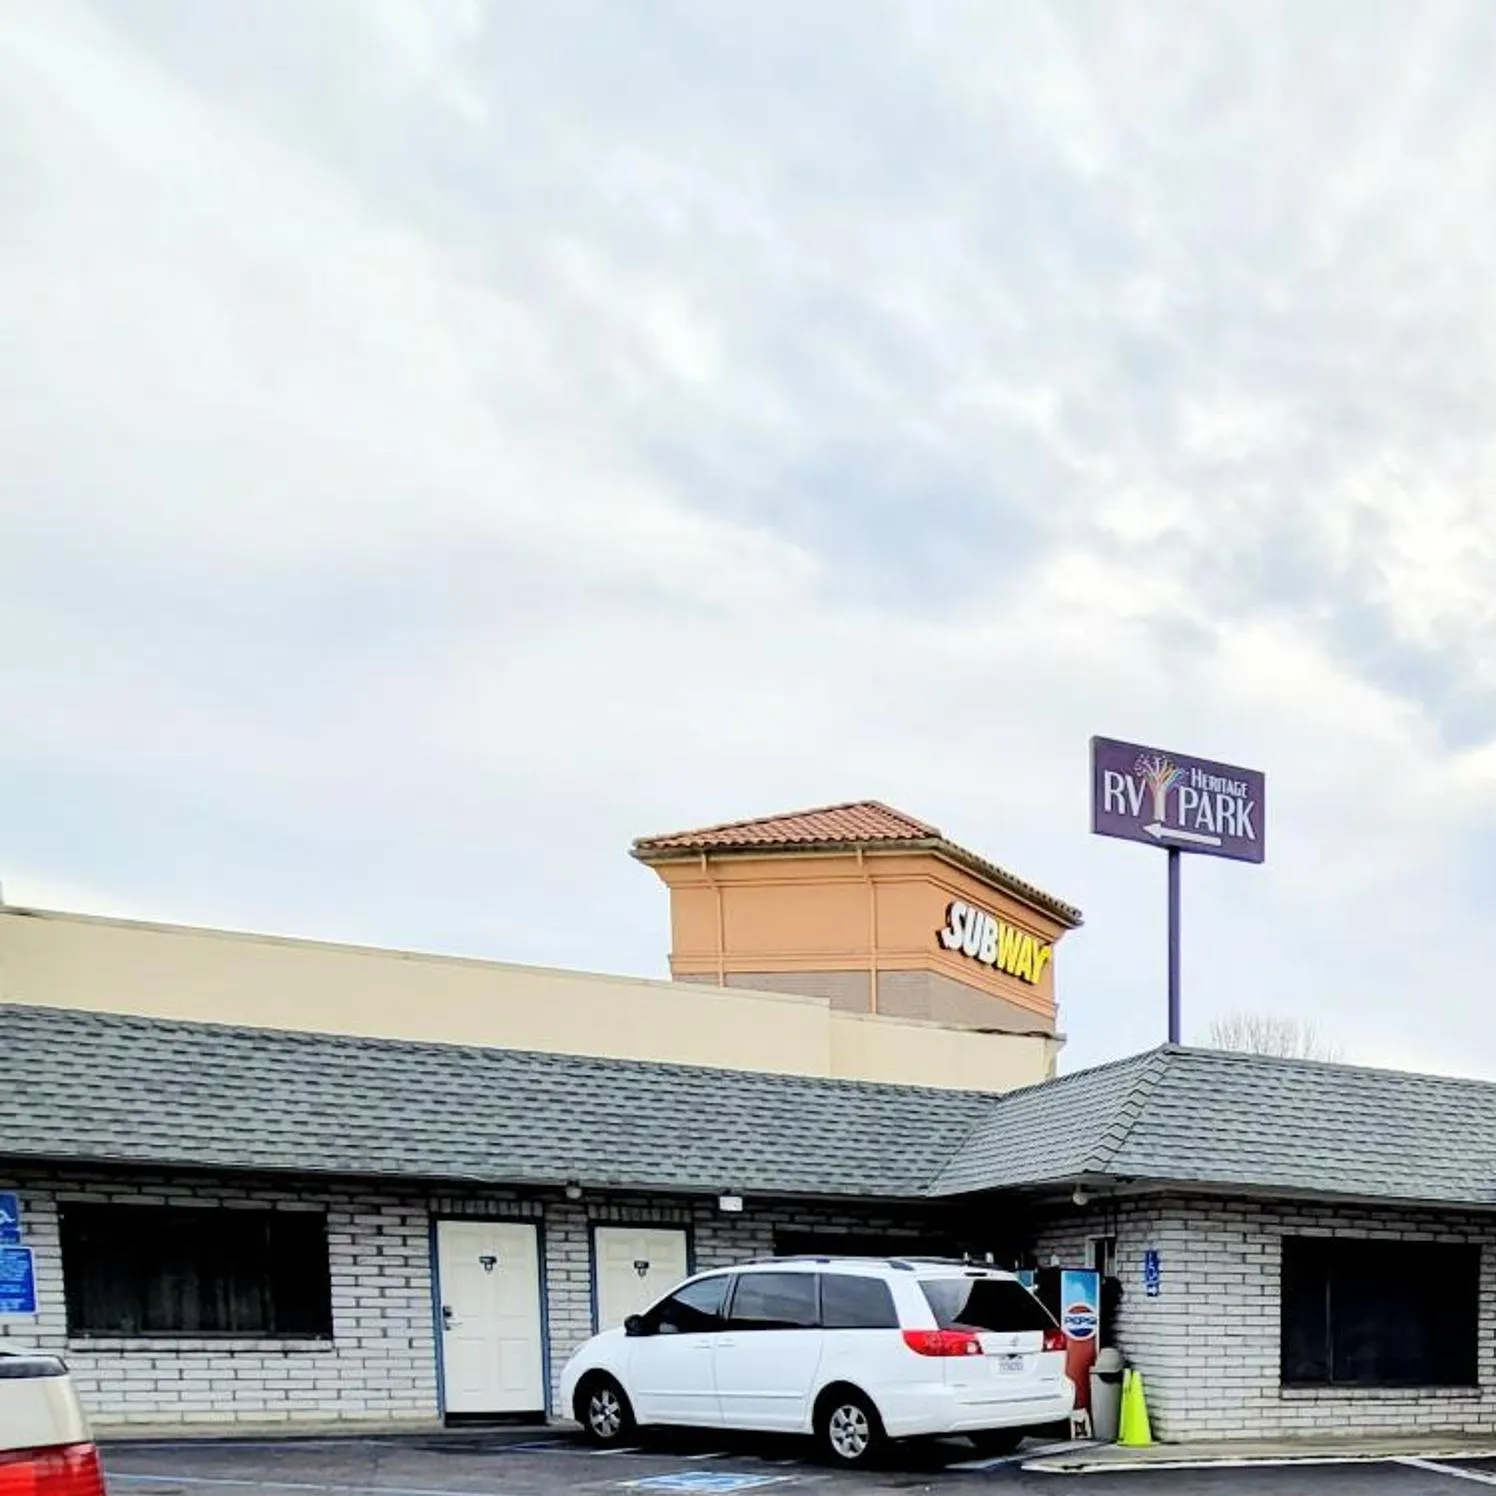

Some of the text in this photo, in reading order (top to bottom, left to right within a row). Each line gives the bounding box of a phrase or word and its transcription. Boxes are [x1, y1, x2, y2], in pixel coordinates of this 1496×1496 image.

[1103, 769, 1256, 840] RV PARK
[1190, 767, 1249, 799] HERITAGE
[939, 900, 1051, 985] SUBWAY
[1064, 1315, 1097, 1326] PEPSI
